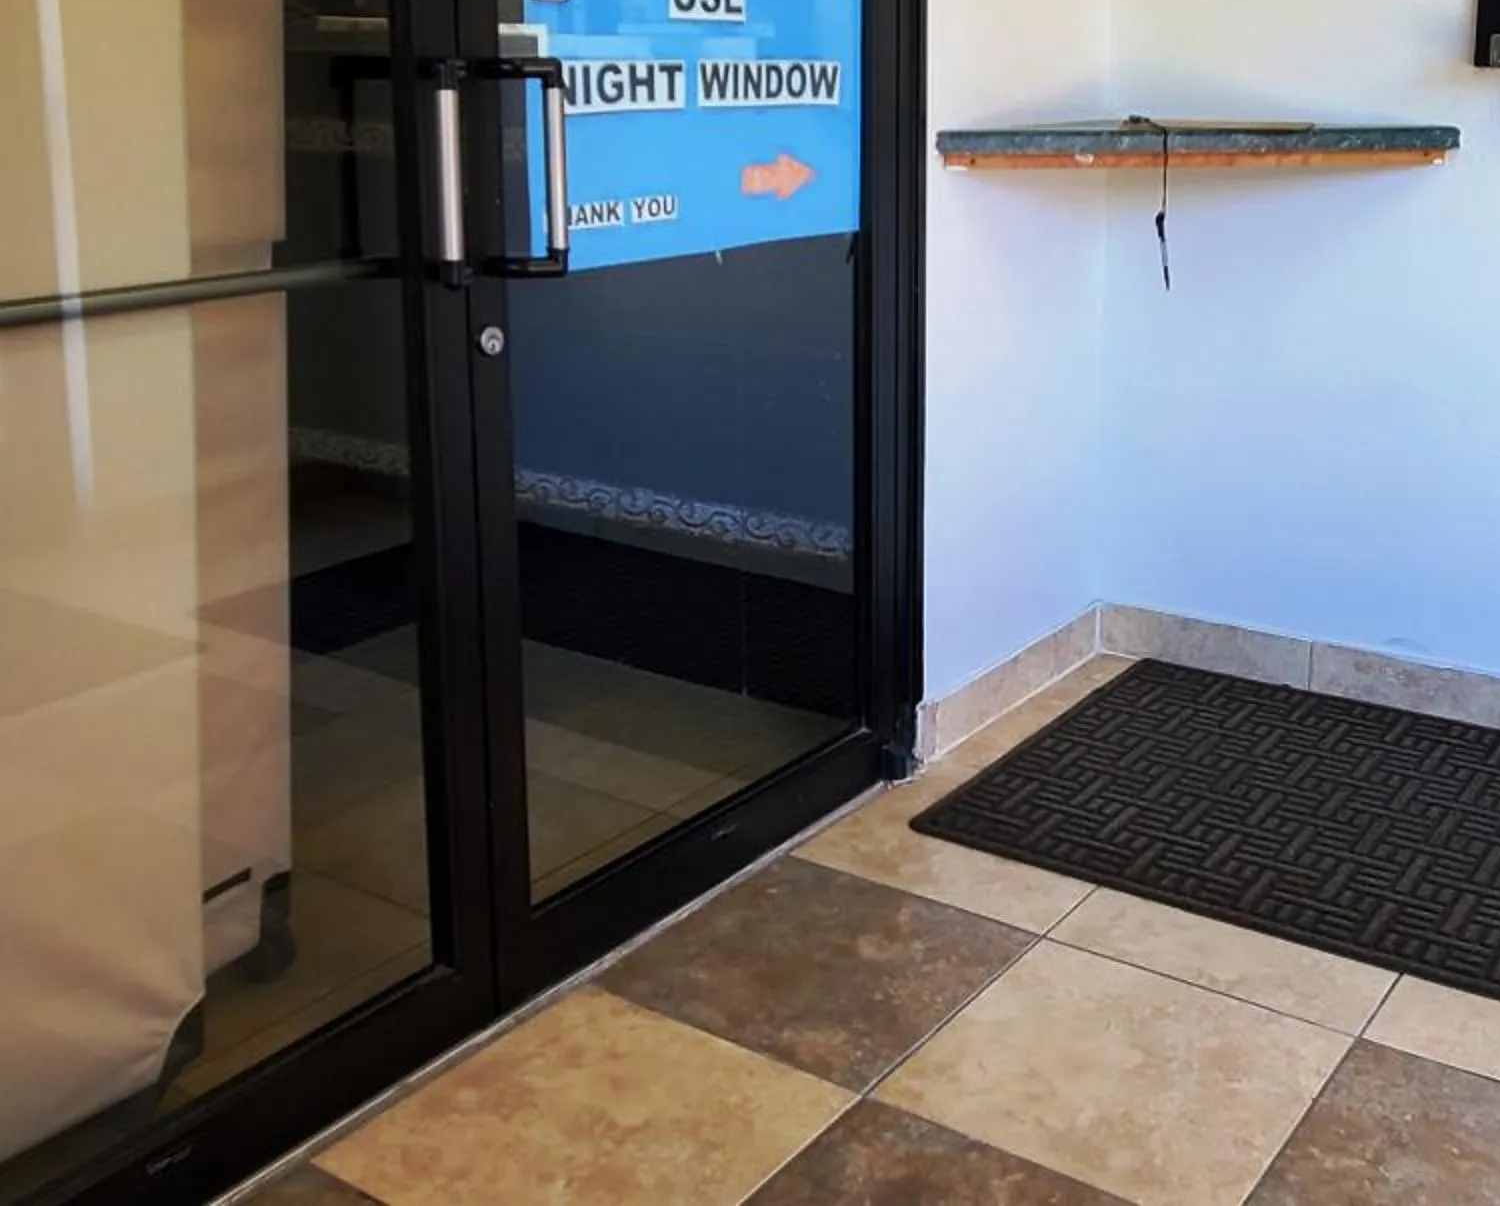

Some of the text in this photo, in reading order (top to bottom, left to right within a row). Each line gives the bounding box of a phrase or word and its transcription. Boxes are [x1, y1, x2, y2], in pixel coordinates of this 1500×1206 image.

[562, 63, 839, 106] NIGHT WINDOW
[634, 195, 676, 220] YOU
